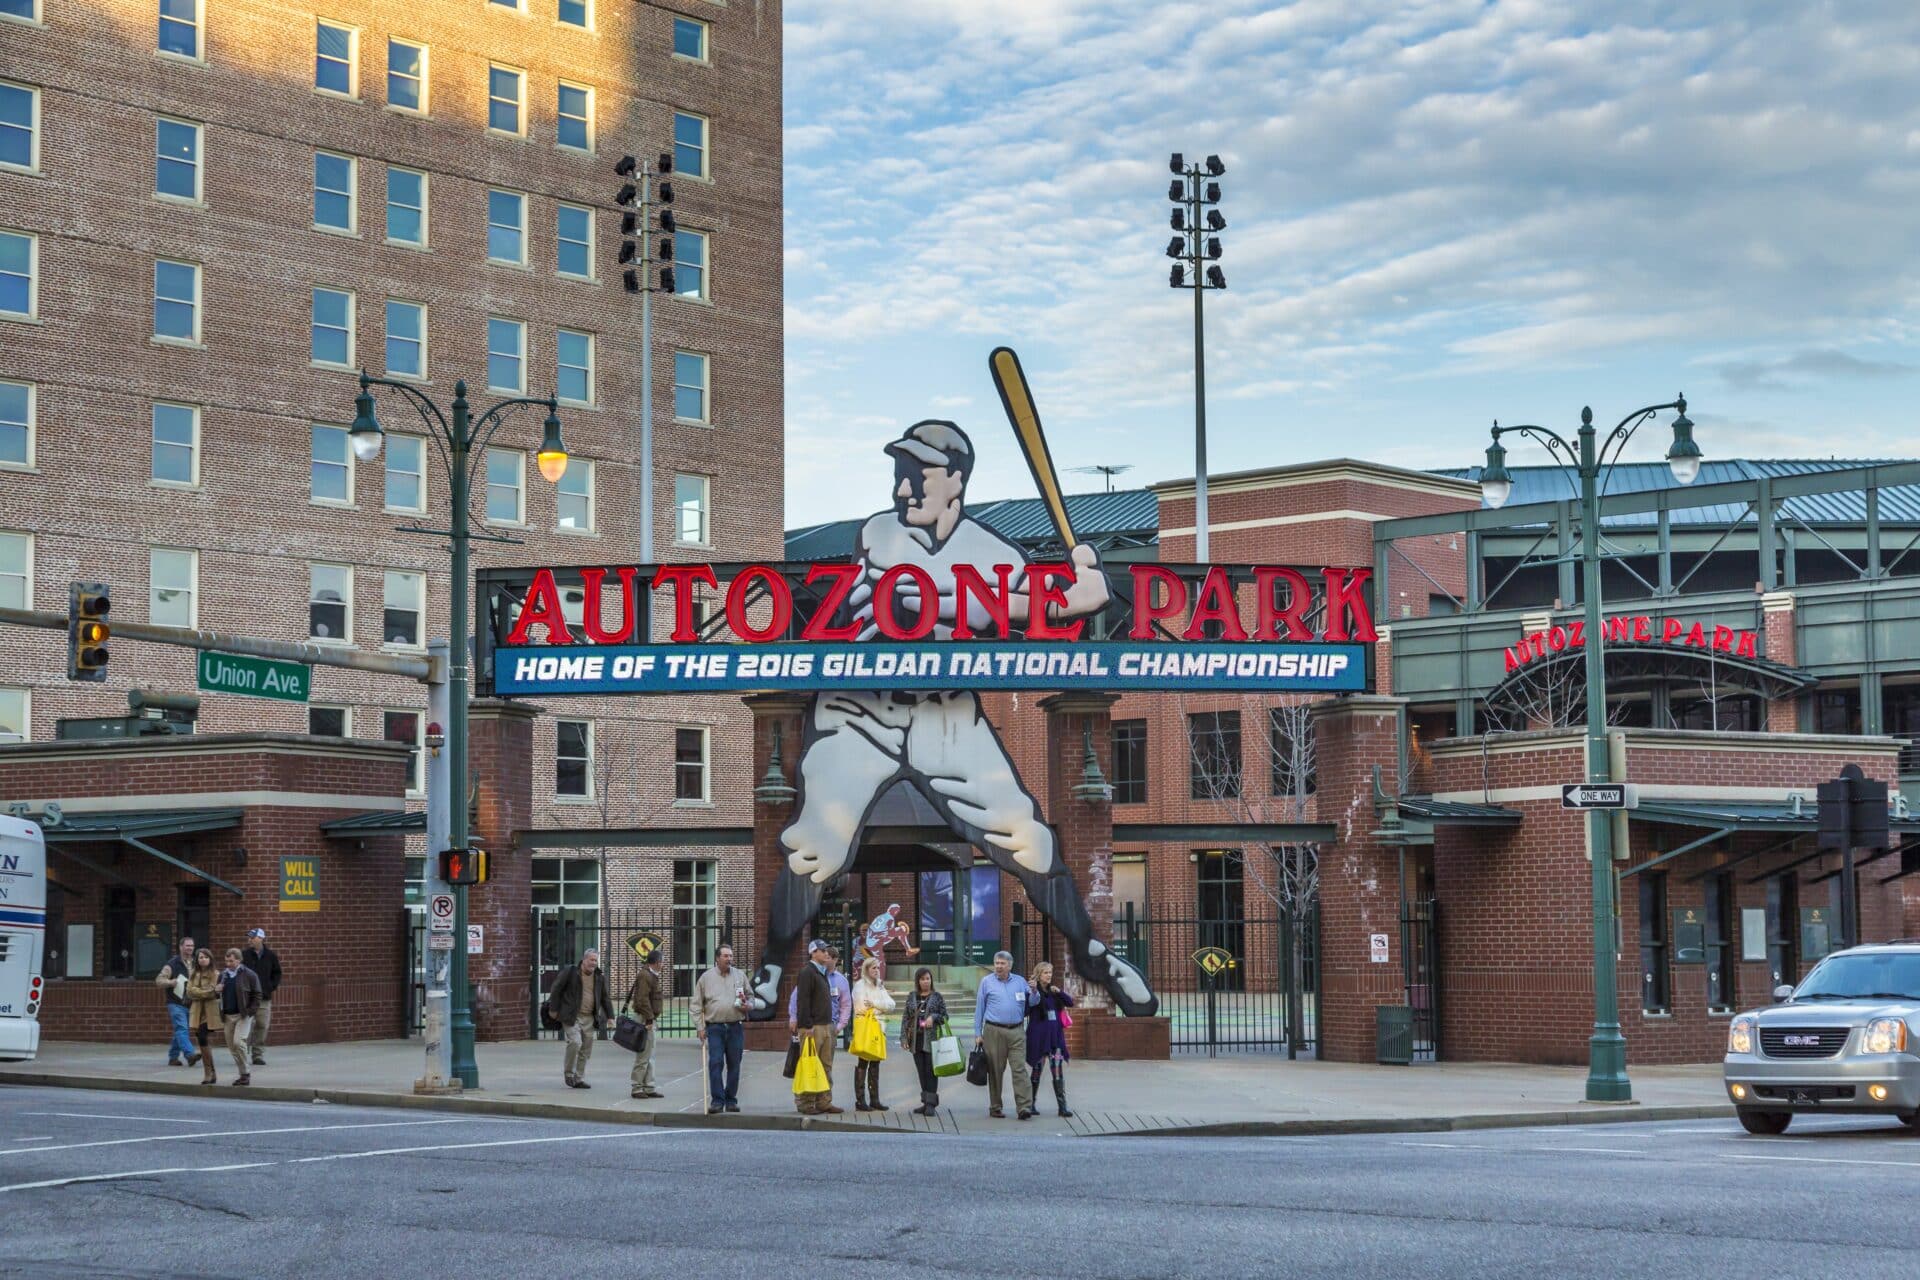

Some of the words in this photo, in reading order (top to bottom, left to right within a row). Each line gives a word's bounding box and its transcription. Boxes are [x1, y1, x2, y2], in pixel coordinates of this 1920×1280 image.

[507, 562, 1085, 644] AUTOZONE
[1128, 565, 1379, 642] PARK
[1662, 617, 1759, 659] PARK
[205, 659, 256, 688] Union
[262, 667, 302, 695] Ave.
[514, 656, 605, 681] HOME
[612, 655, 656, 680] OF
[665, 654, 729, 679] THE
[736, 654, 815, 678] 2016
[822, 653, 941, 677] GILDAN
[949, 653, 1109, 677] NATIONAL
[1118, 654, 1348, 678] CHAMPIONSHIP
[1581, 791, 1598, 801] ONE
[1600, 791, 1618, 801] WAY
[285, 861, 315, 877] WILL
[285, 879, 315, 896] CALL
[1784, 1035, 1820, 1046] GMC
